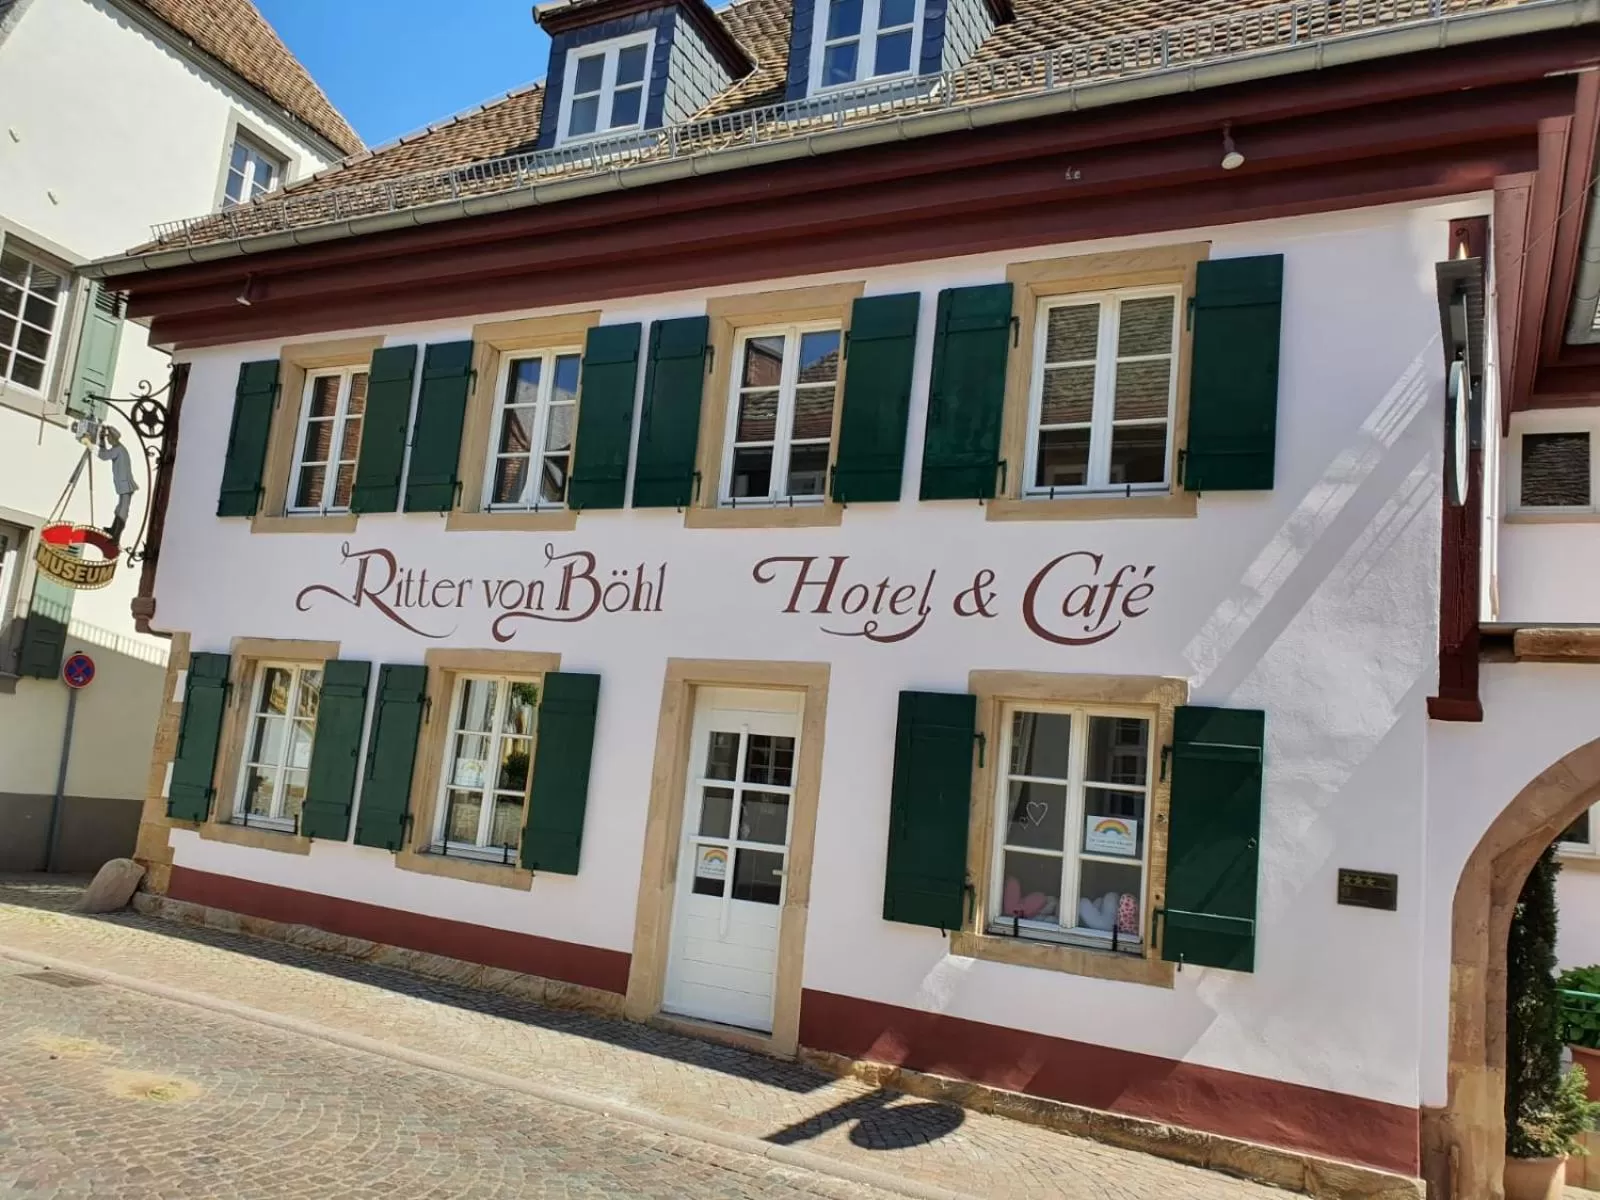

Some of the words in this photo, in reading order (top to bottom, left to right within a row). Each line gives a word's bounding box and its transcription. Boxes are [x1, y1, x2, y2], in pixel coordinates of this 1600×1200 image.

[37, 544, 114, 583] MUSEUM
[295, 541, 472, 639] Ritter
[482, 579, 545, 611] von
[492, 542, 668, 642] Böhl
[752, 555, 937, 643] Hotel
[953, 568, 999, 618] &
[1022, 551, 1157, 646] Café
